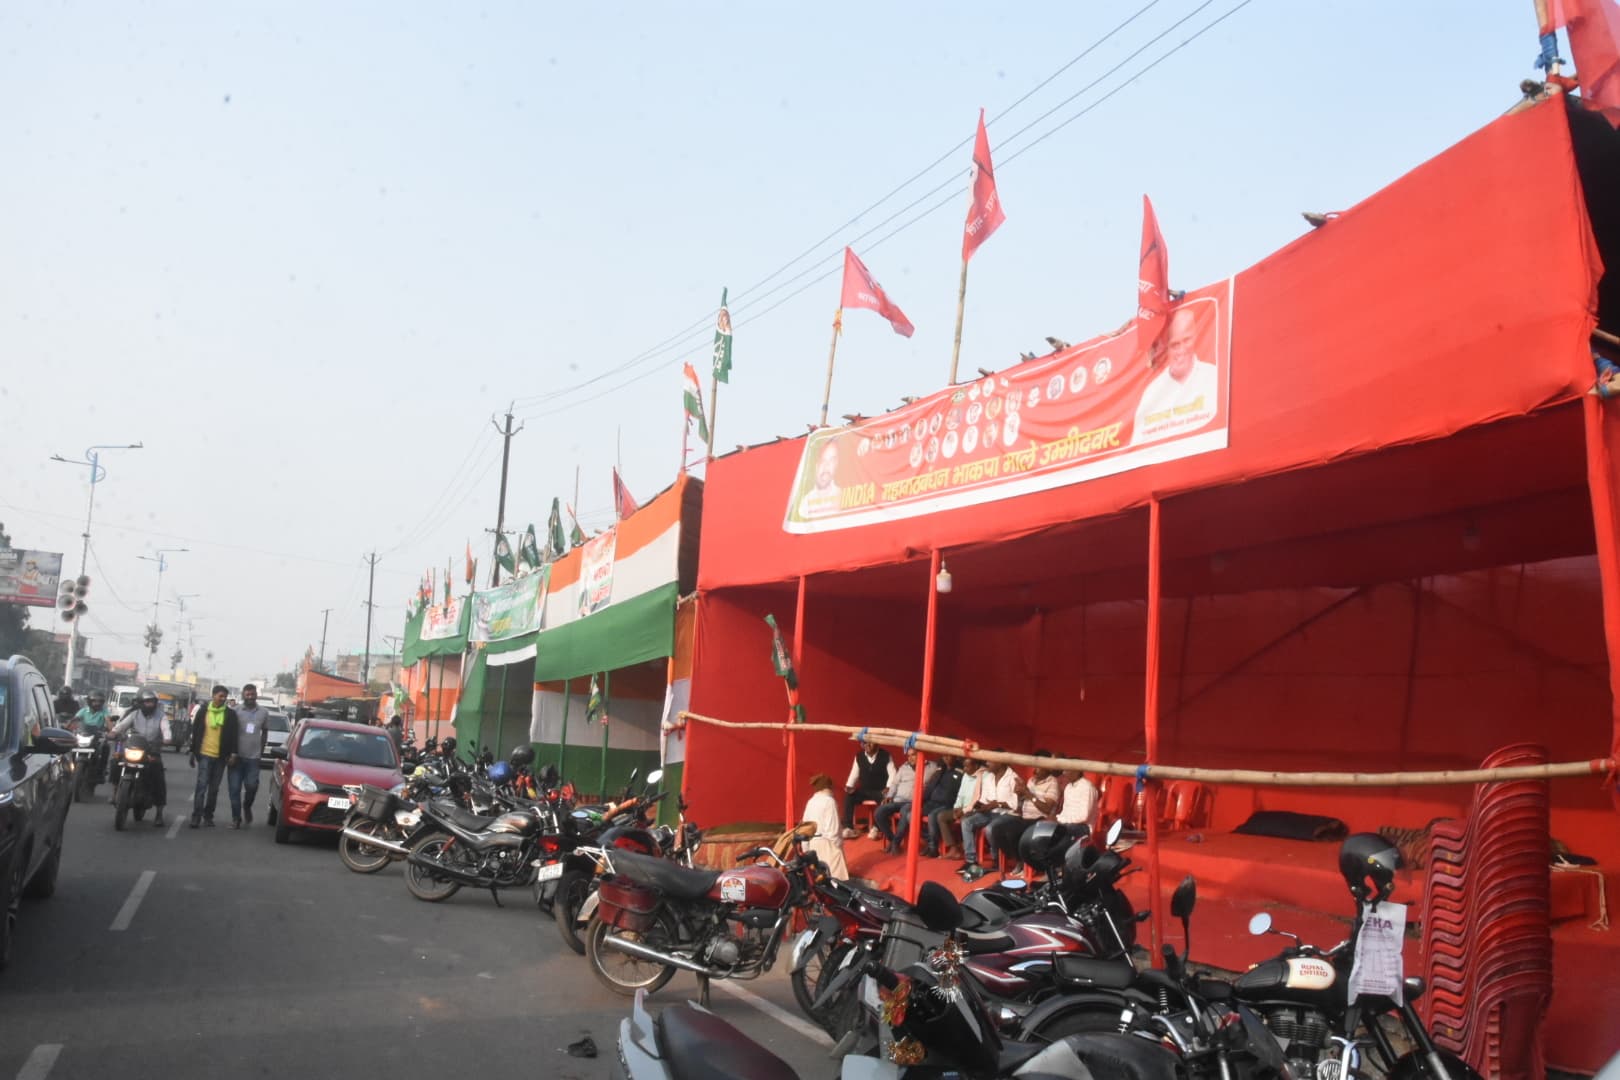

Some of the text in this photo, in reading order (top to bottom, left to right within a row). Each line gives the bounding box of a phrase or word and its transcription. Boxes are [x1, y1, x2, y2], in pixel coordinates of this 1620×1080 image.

[840, 481, 876, 510] INDIA
[952, 456, 999, 484] भाकपा
[1003, 440, 1038, 472] माले
[1040, 423, 1122, 464] उम्मीदवार
